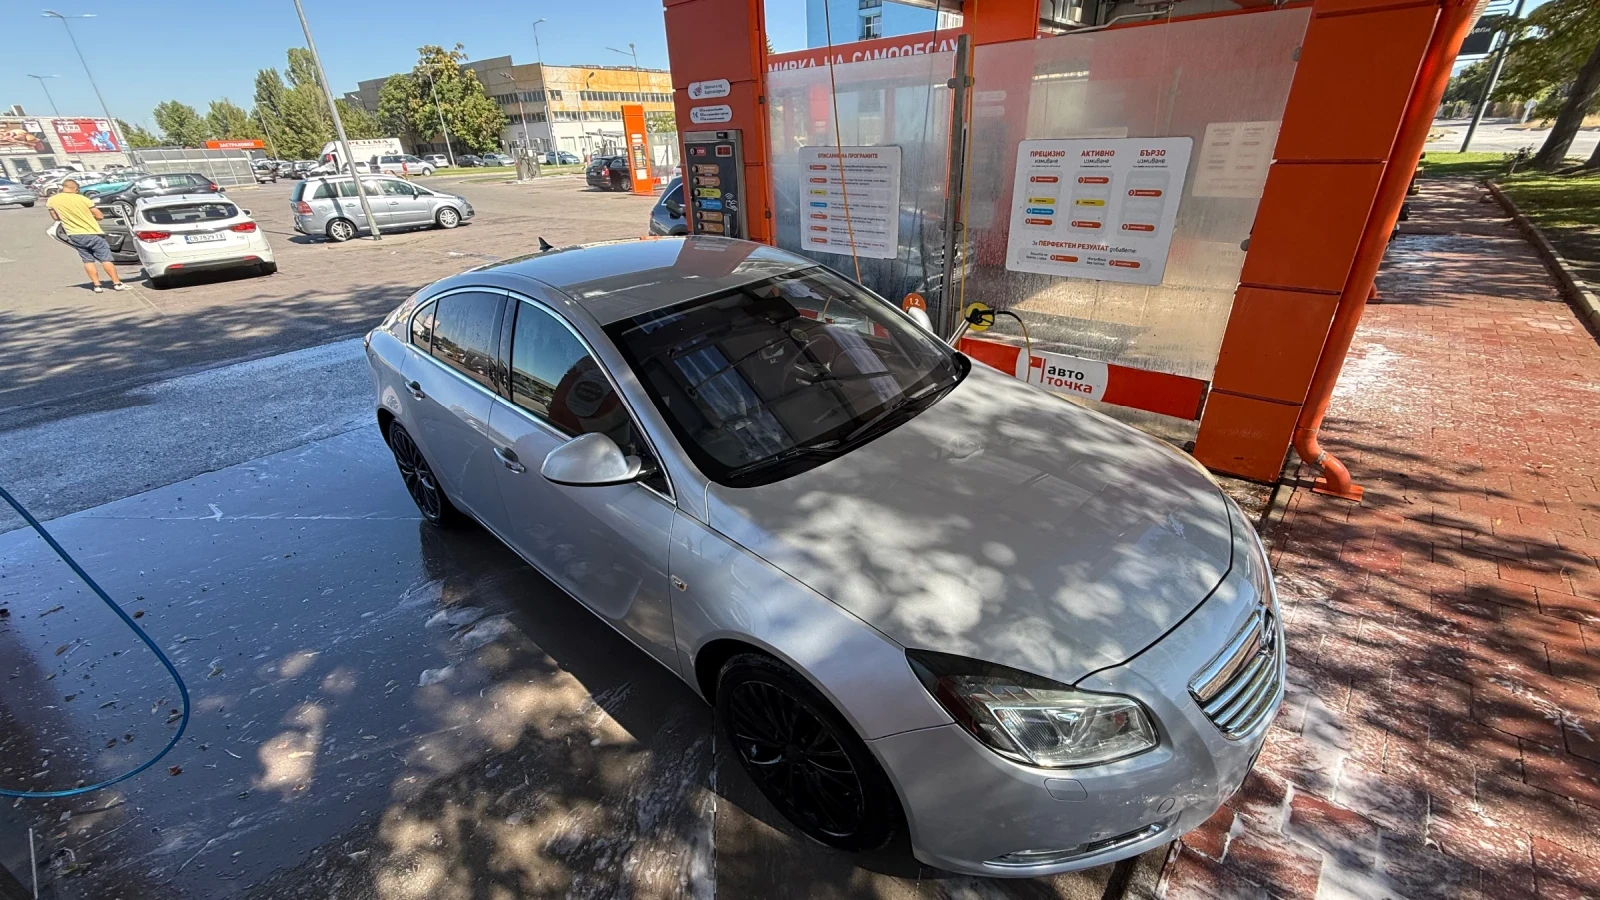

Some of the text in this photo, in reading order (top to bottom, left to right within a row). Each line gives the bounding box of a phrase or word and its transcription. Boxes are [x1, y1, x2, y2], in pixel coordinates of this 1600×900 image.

[1030, 150, 1065, 158] ПРЕЦИЗНО
[1140, 149, 1166, 157] БЪРЗО
[1038, 240, 1077, 249] ПЕРФЕКТЕН
[1077, 243, 1109, 251] РЕЗУЛТАТ
[1047, 365, 1084, 381] авто
[1046, 376, 1093, 394] точка
